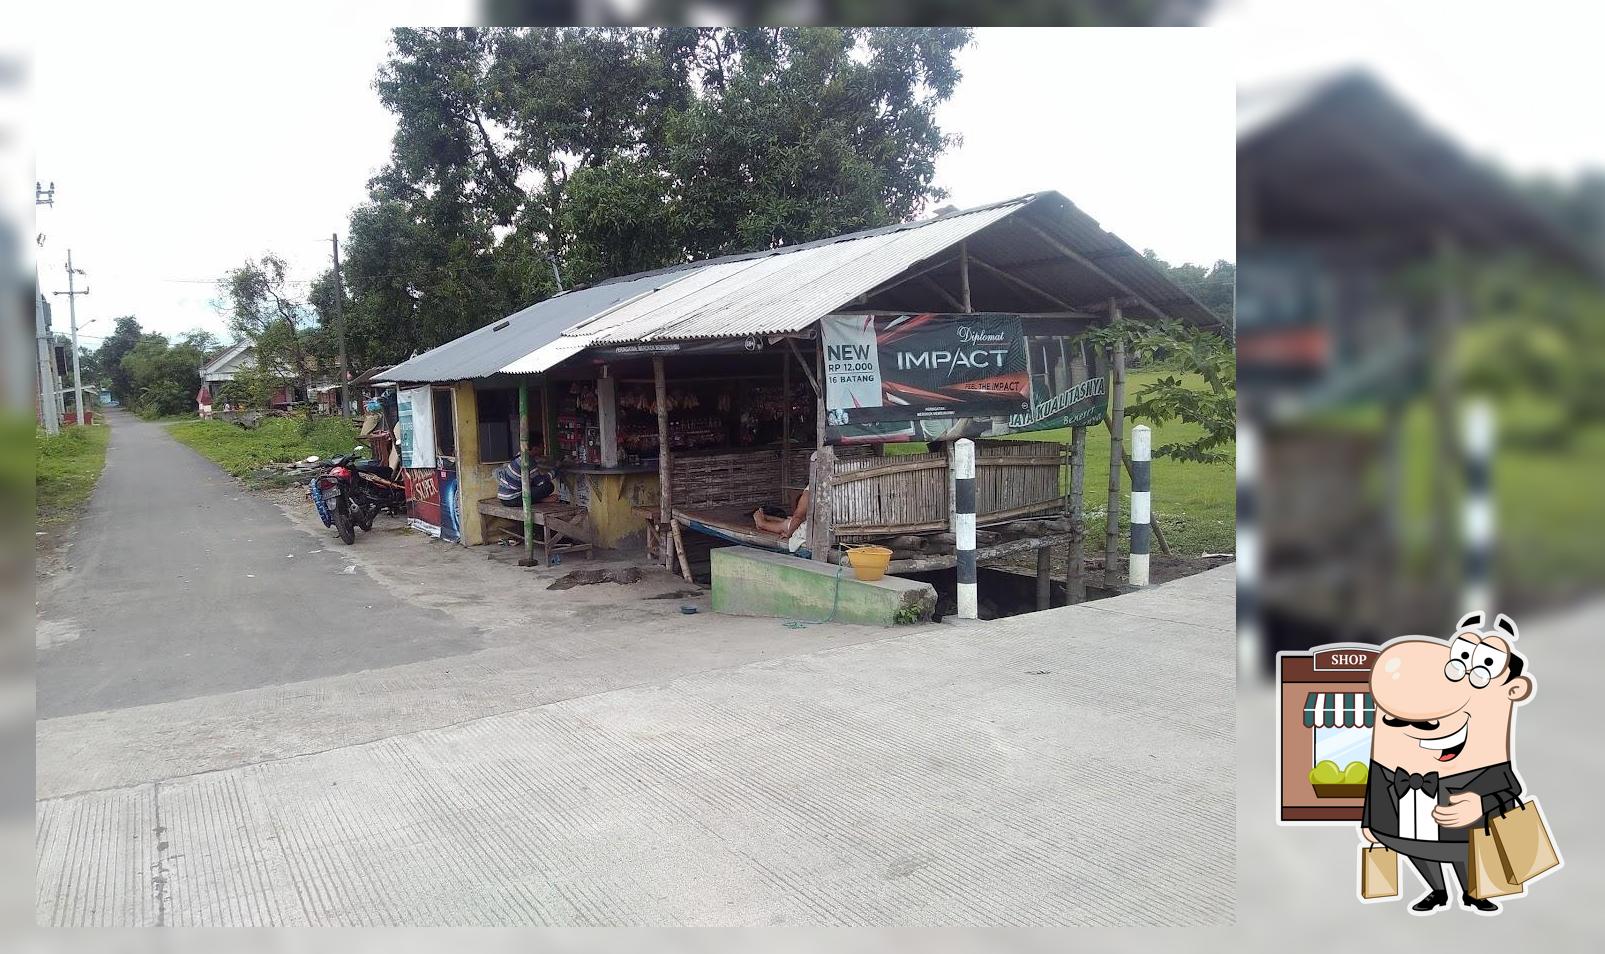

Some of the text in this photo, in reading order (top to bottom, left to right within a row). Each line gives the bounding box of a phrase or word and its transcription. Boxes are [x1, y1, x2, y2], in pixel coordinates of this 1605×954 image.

[957, 325, 1004, 345] Diplomat
[828, 345, 870, 360] NEW
[829, 363, 873, 372] RP 12.000
[897, 348, 1008, 377] IMPACT
[829, 375, 874, 384] 16 BATANG
[991, 381, 1020, 391] IMPACT
[415, 477, 439, 501] SUPER
